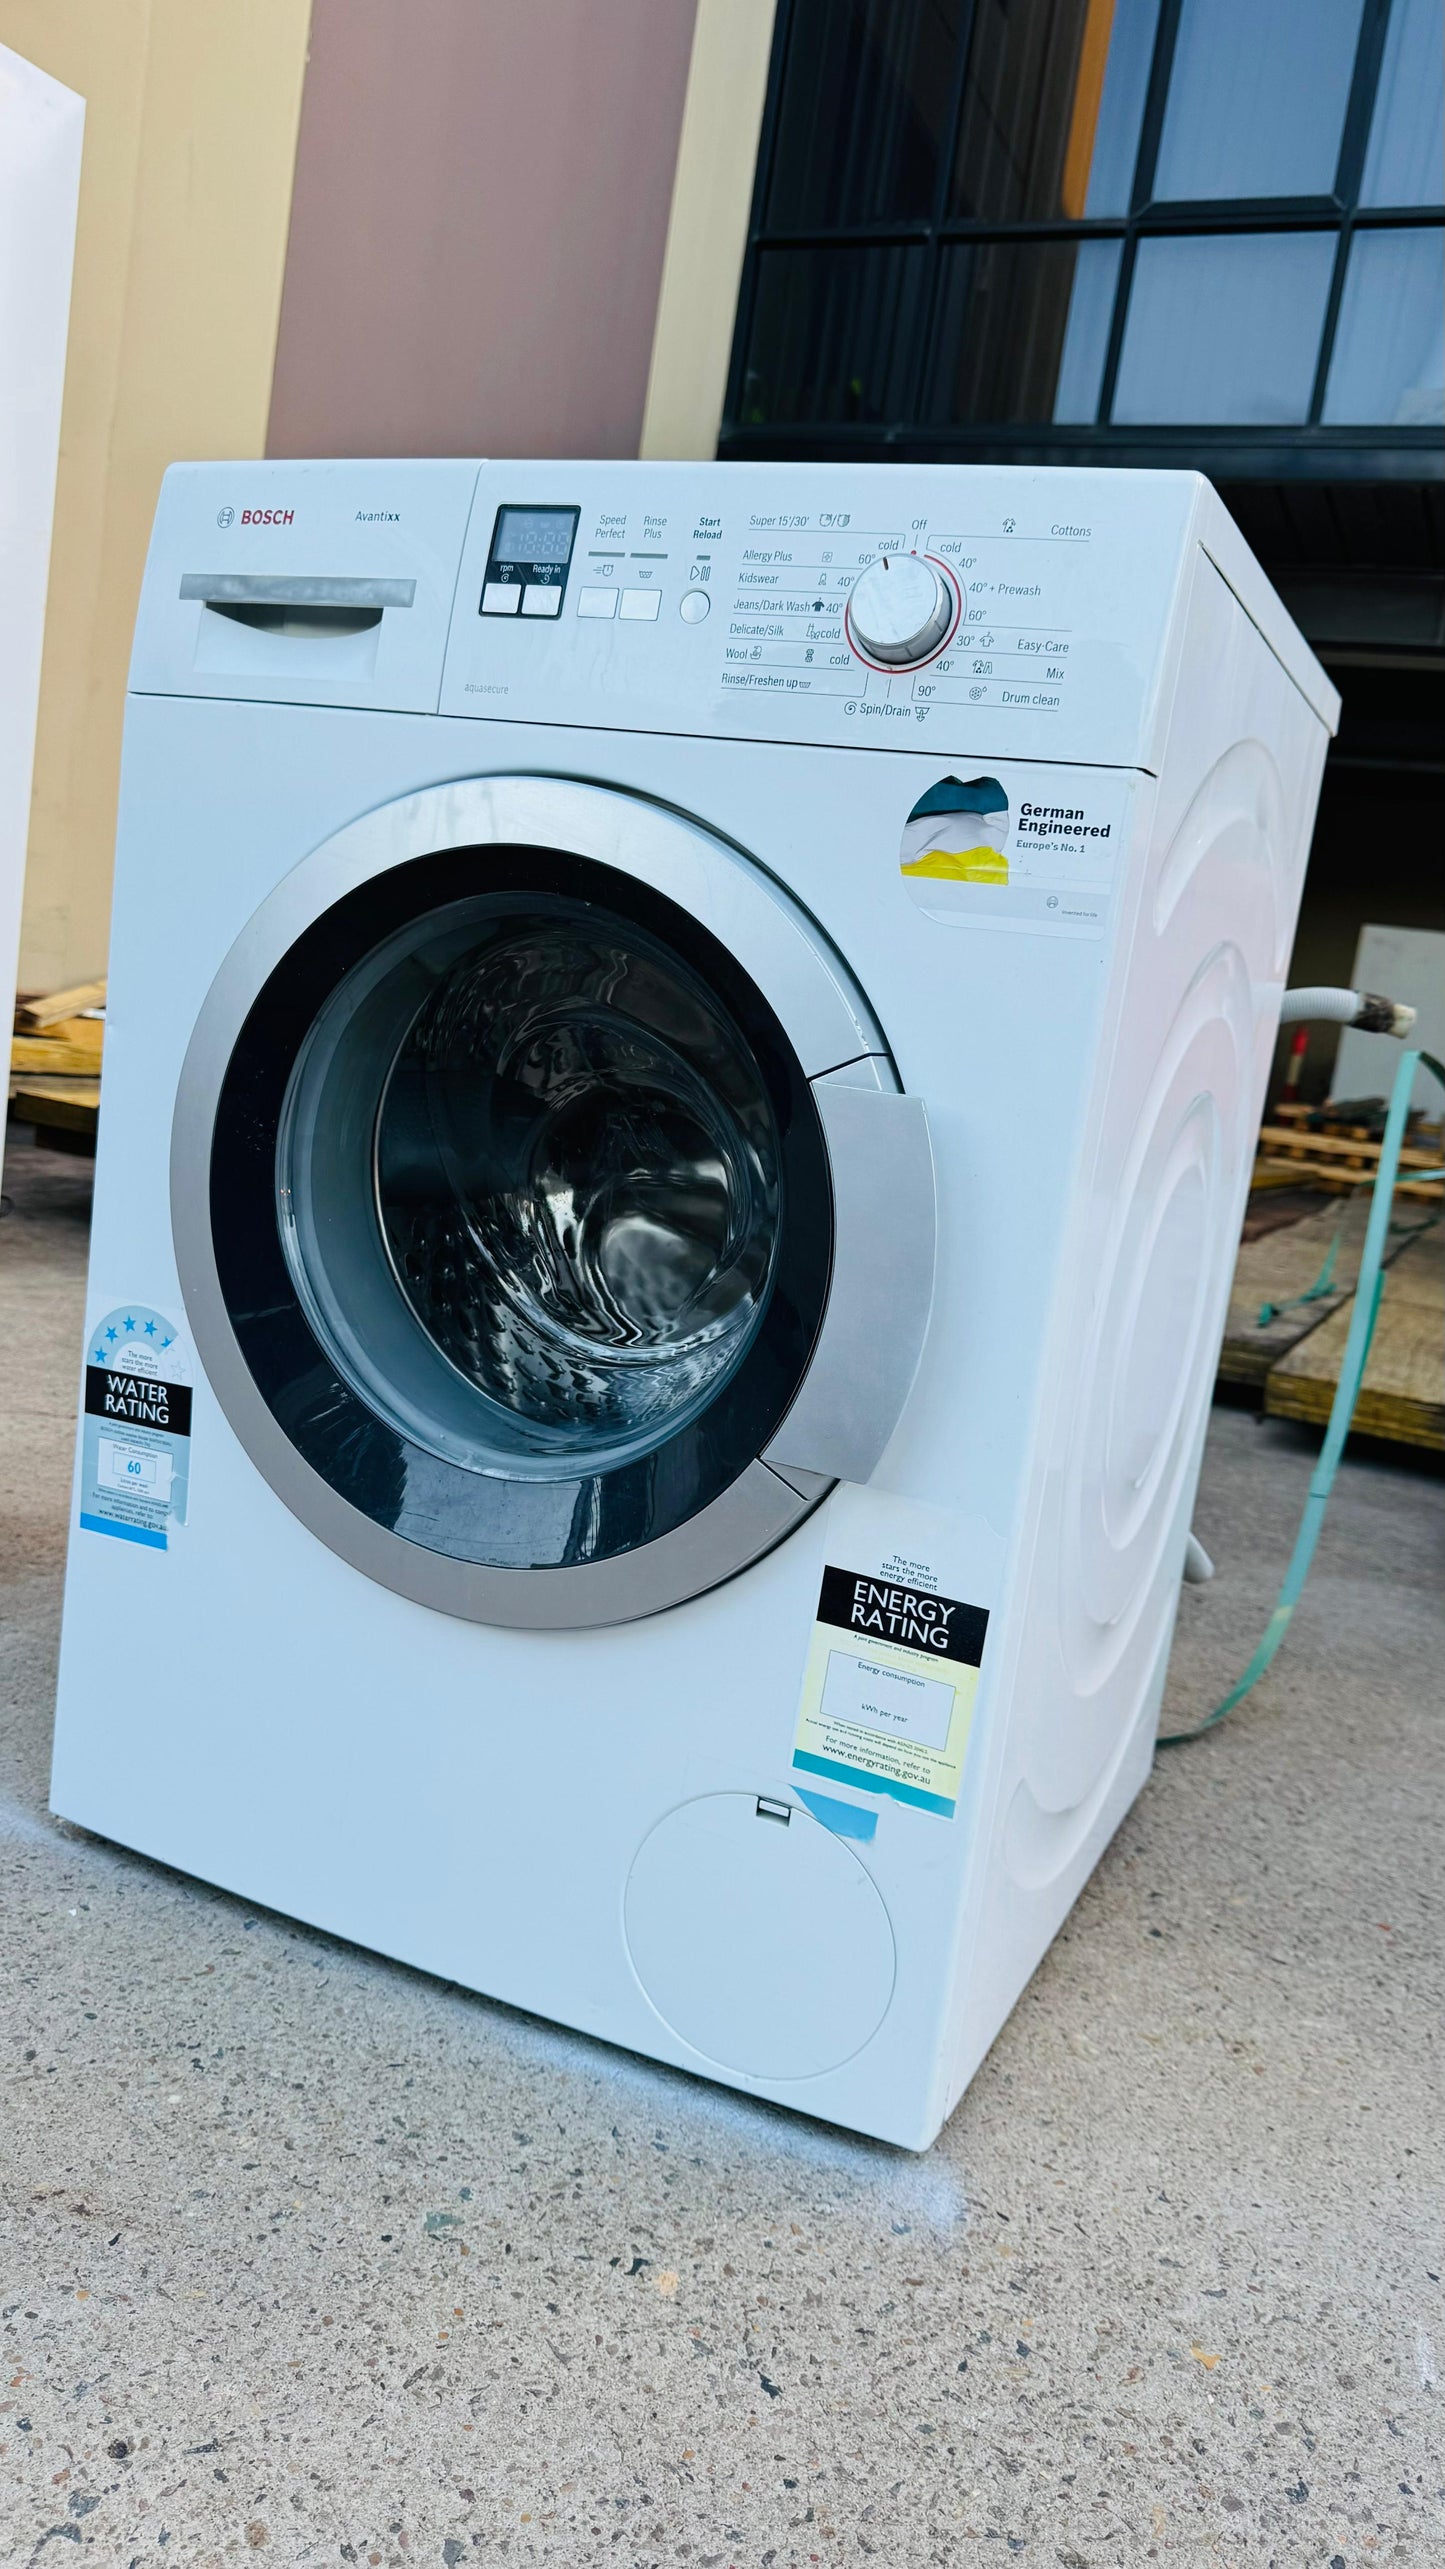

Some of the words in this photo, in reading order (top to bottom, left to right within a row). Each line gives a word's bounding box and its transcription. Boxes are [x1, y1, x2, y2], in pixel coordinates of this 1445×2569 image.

[241, 510, 294, 525] BOSCH
[354, 510, 400, 522] Avantixx
[600, 515, 626, 526] Speed
[644, 516, 668, 526] Rinse
[700, 517, 721, 527] Start
[750, 515, 776, 528] Super
[912, 519, 928, 530] Off
[1050, 524, 1092, 537] Cottons
[595, 528, 626, 539] Perfect
[644, 528, 662, 539] Plus
[693, 530, 722, 540] Reload
[878, 540, 900, 551] cold
[940, 542, 962, 553] cold
[742, 550, 772, 563] Allergy
[773, 550, 792, 562] Plus
[500, 565, 514, 573] rpm
[532, 564, 553, 574] Ready
[554, 564, 560, 572] in
[738, 572, 779, 584] Kidswear
[998, 584, 1041, 596] Prewash
[733, 600, 784, 612] Jeans/Dark
[786, 601, 810, 612] Wash
[730, 623, 784, 636] Delicate/Silk
[820, 628, 841, 639] cold
[726, 648, 748, 660] Wool
[830, 654, 850, 665] cold
[1046, 668, 1064, 679] Mix
[721, 673, 785, 687] Rinse/Freshen
[786, 678, 798, 689] up
[464, 683, 509, 694] aquasecure
[1002, 691, 1030, 704] Drum
[1032, 693, 1060, 706] clean
[860, 702, 911, 716] Spin/Drain
[1020, 803, 1084, 820] German
[1018, 818, 1111, 838] Engineered
[1016, 840, 1059, 852] Europe's
[1060, 843, 1078, 853] No.
[1079, 844, 1086, 853] 1
[128, 1350, 138, 1359] The
[138, 1354, 152, 1362] more
[121, 1357, 134, 1365] stars
[144, 1362, 158, 1370] more
[107, 1374, 168, 1404] WATER
[105, 1394, 170, 1424] RATING
[127, 1460, 142, 1475] 60
[892, 1555, 908, 1566] The
[910, 1561, 930, 1572] more
[882, 1562, 900, 1572] stars
[902, 1567, 916, 1576] the
[916, 1572, 938, 1583] more
[880, 1570, 906, 1583] energy
[907, 1576, 938, 1592] efficient
[853, 1580, 956, 1626] ENERGY
[850, 1602, 950, 1649] RATING
[857, 1661, 880, 1676] Energy
[882, 1670, 926, 1688] consumption
[861, 1703, 878, 1714] kWh
[880, 1710, 892, 1718] per
[892, 1714, 908, 1722] year
[825, 1735, 838, 1744] For
[839, 1741, 858, 1750] more
[859, 1746, 901, 1766] information,
[902, 1760, 921, 1772] refer
[822, 1744, 931, 1785] www.energyrating.gov.au
